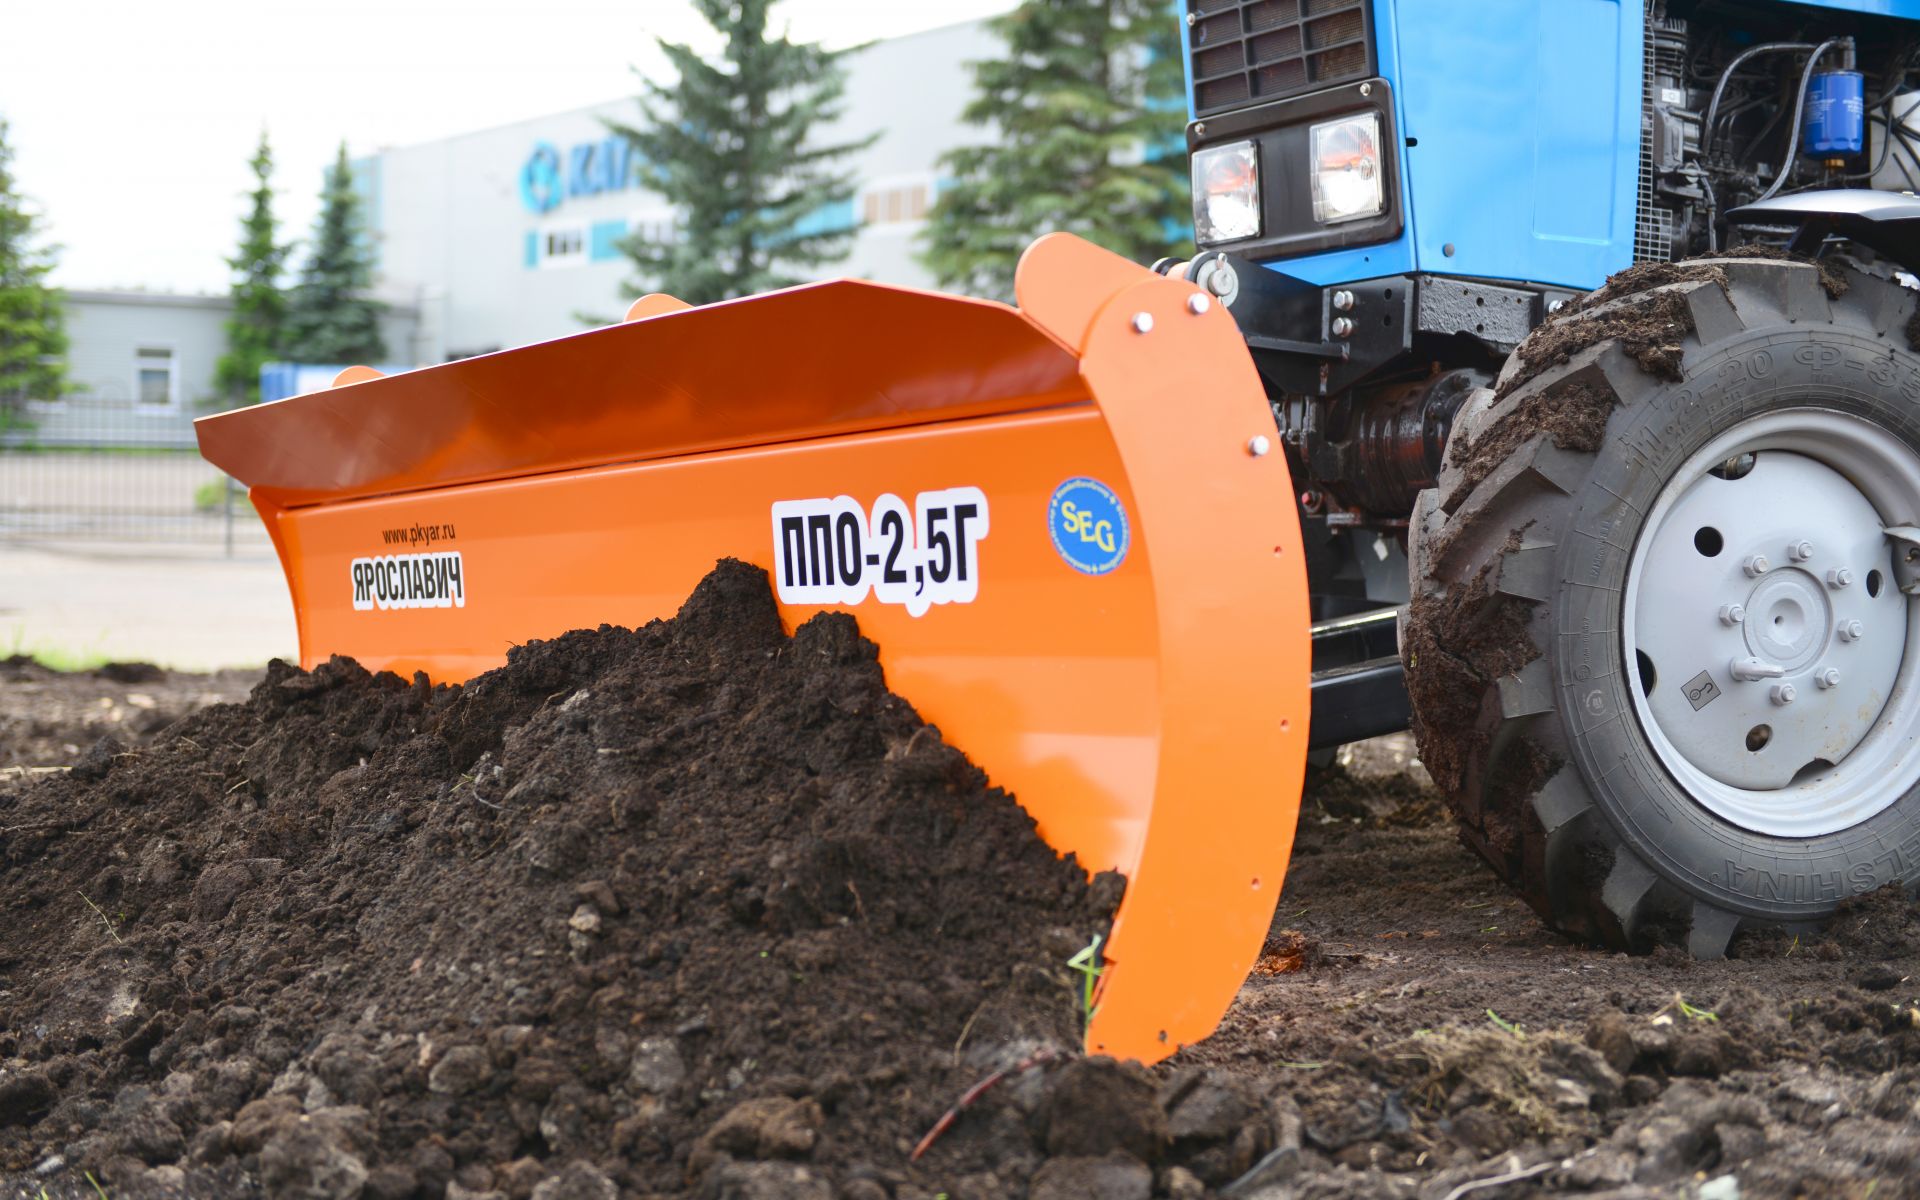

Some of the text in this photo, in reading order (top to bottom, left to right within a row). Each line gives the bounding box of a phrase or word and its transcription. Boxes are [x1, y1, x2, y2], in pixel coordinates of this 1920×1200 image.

[382, 522, 456, 547] www.pkyar.ru
[781, 503, 978, 597] ППО-2,5Г
[1061, 500, 1116, 552] SEG
[353, 557, 462, 602] ЯРОСЛАВИЧ
